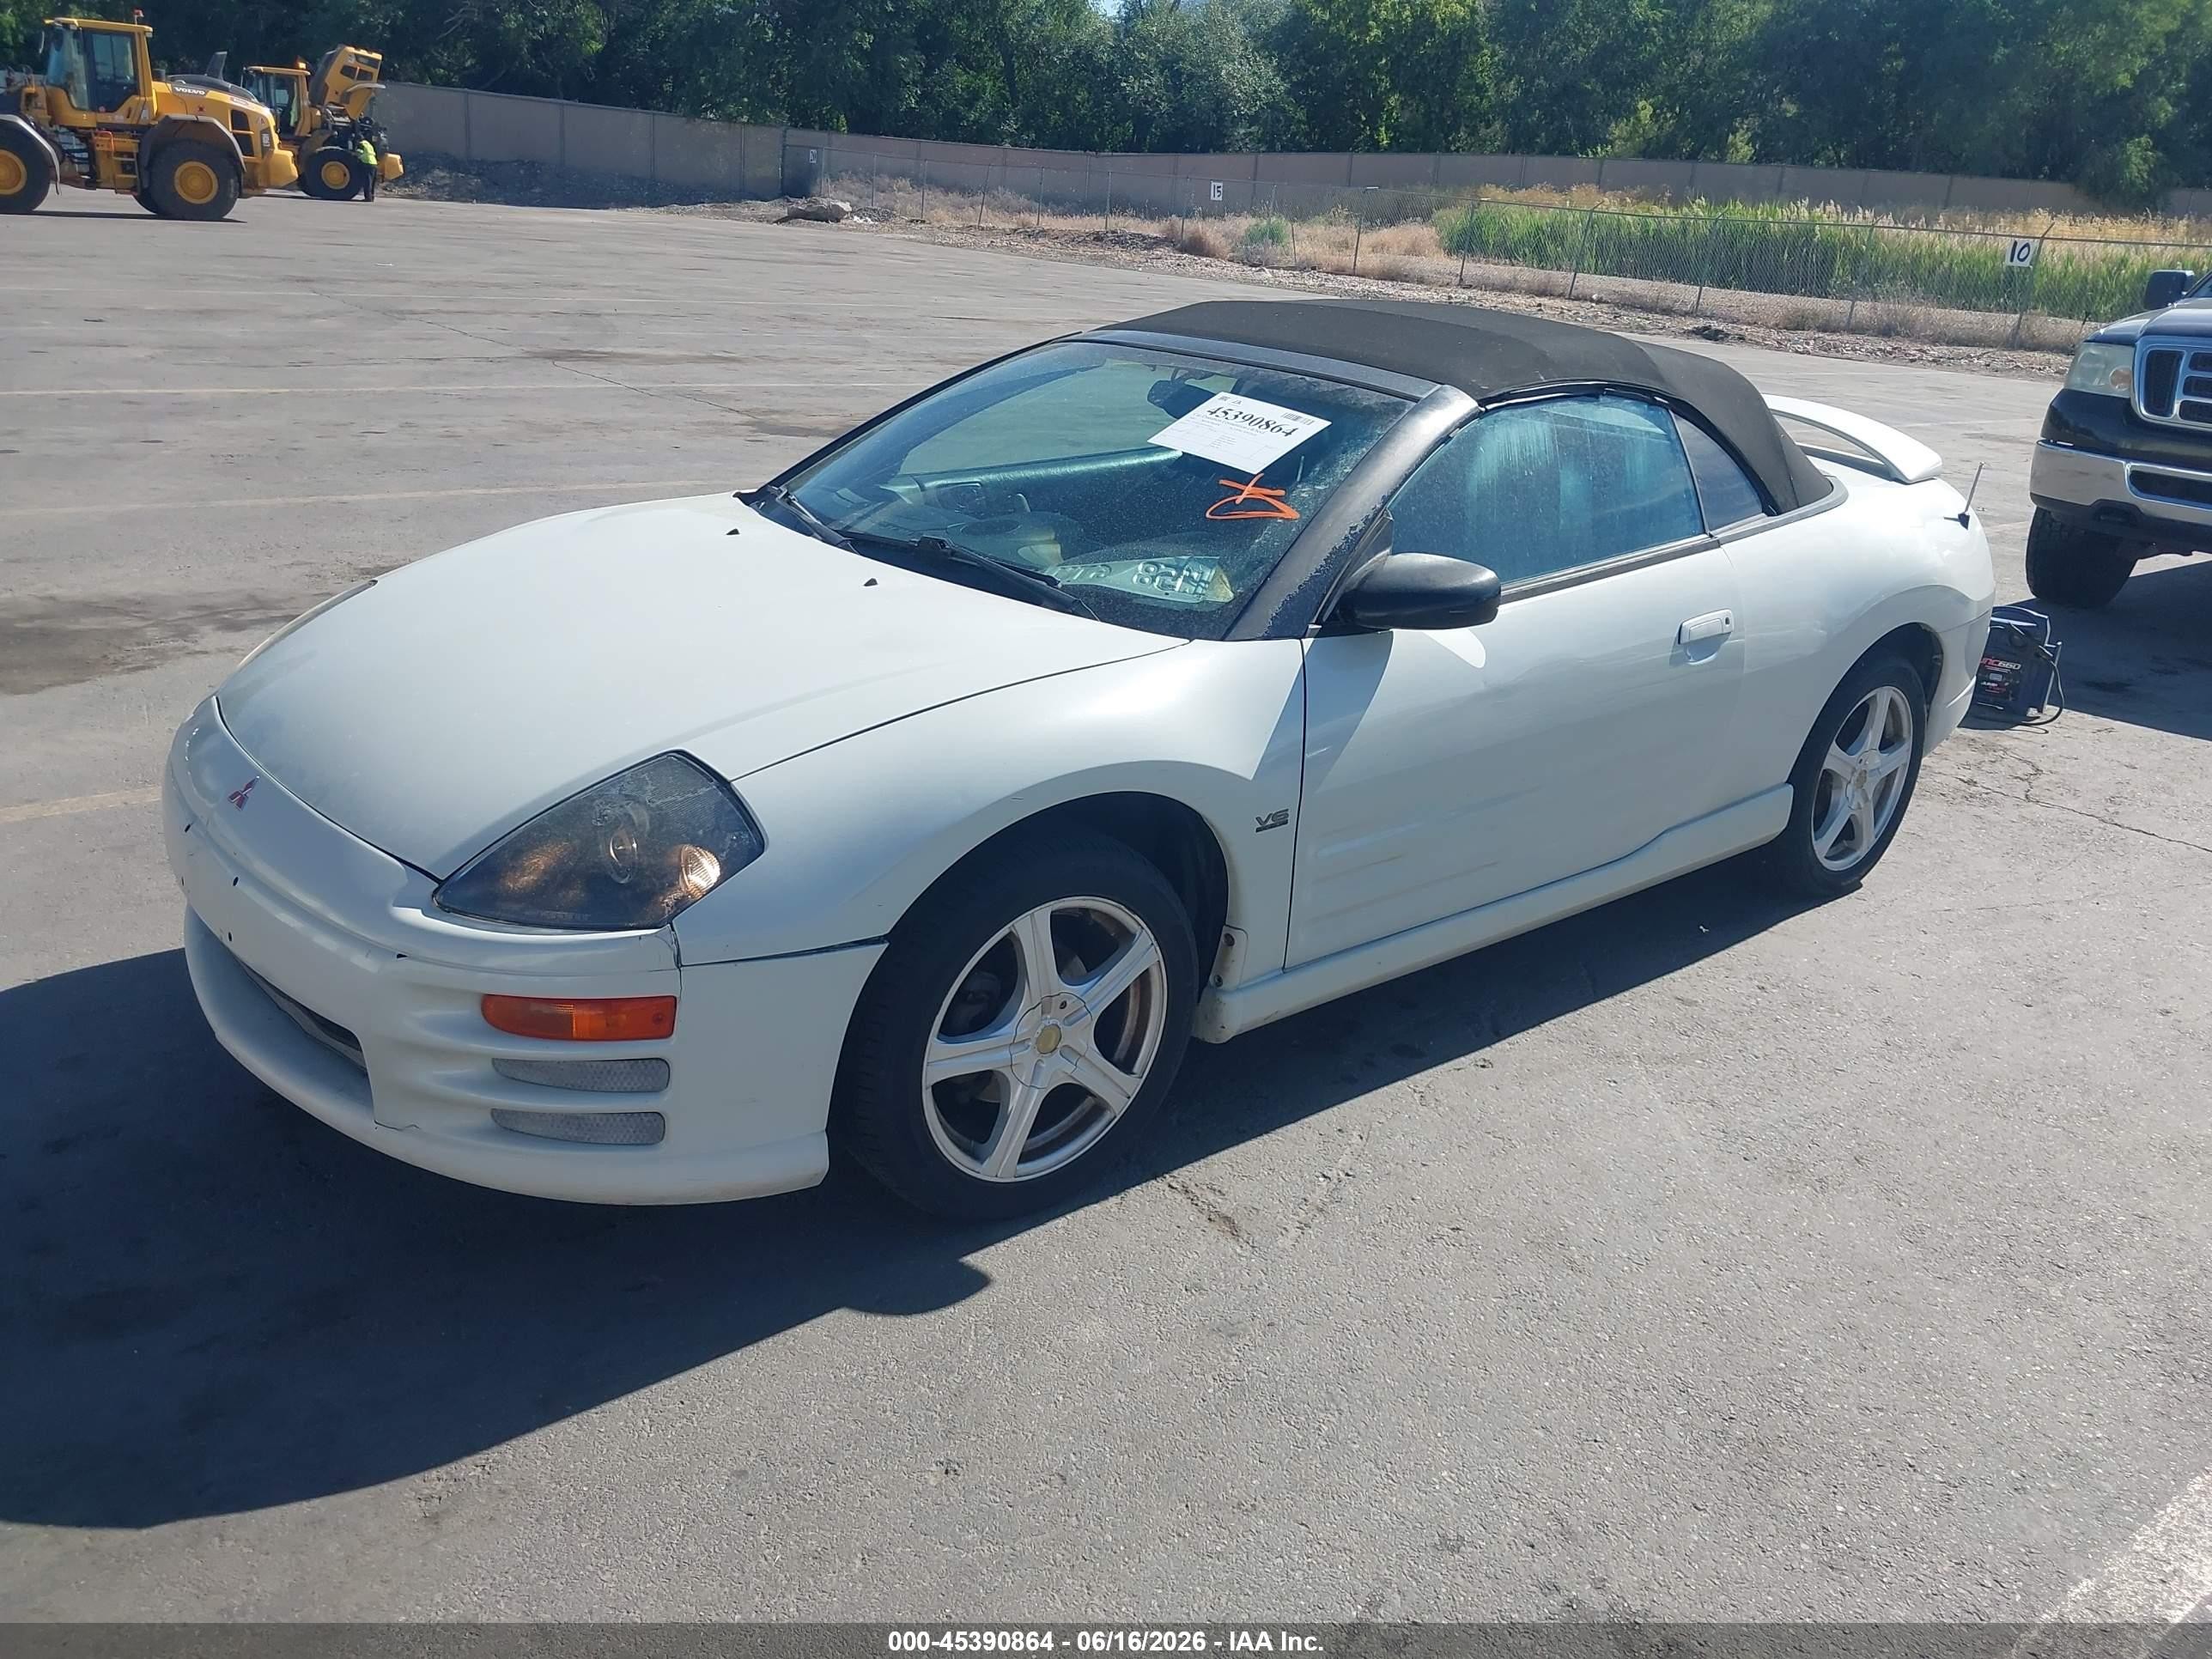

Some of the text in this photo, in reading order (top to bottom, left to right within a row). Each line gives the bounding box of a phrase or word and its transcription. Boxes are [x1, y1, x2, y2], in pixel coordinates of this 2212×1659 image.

[174, 87, 205, 95] VOLVO
[1212, 184, 1222, 198] 15
[2009, 240, 2031, 263] 10
[1206, 406, 1299, 437] 45390864
[1255, 808, 1290, 827] V6
